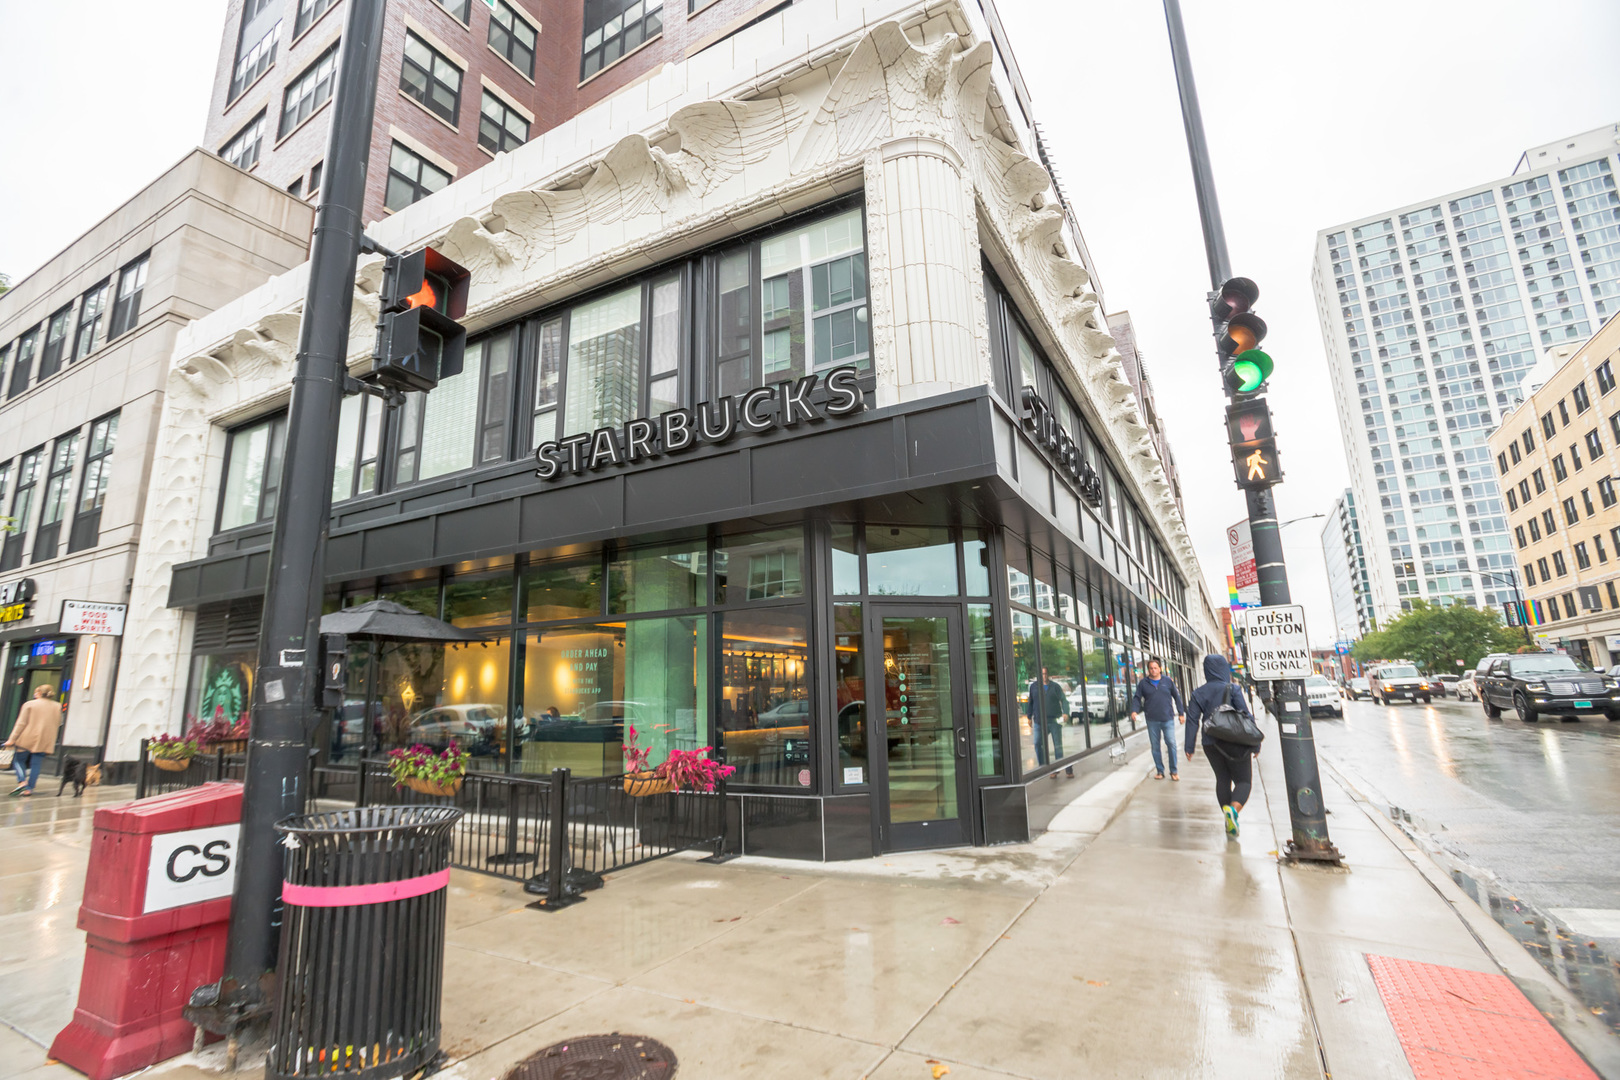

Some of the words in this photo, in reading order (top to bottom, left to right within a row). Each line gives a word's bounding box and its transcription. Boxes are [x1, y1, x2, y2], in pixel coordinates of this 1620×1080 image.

[535, 366, 864, 481] STARBUCKS
[1257, 613, 1293, 624] PUSH
[73, 624, 112, 633] SPIRITS
[1250, 623, 1303, 637] BUTTON
[561, 650, 583, 658] ORDER
[584, 648, 608, 657] AHEAD
[1253, 650, 1274, 661] FOR
[1276, 649, 1307, 659] WALK
[570, 662, 583, 671] AND
[585, 662, 598, 671] PAY
[1259, 660, 1302, 671] SIGNAL
[166, 839, 231, 883] CS
